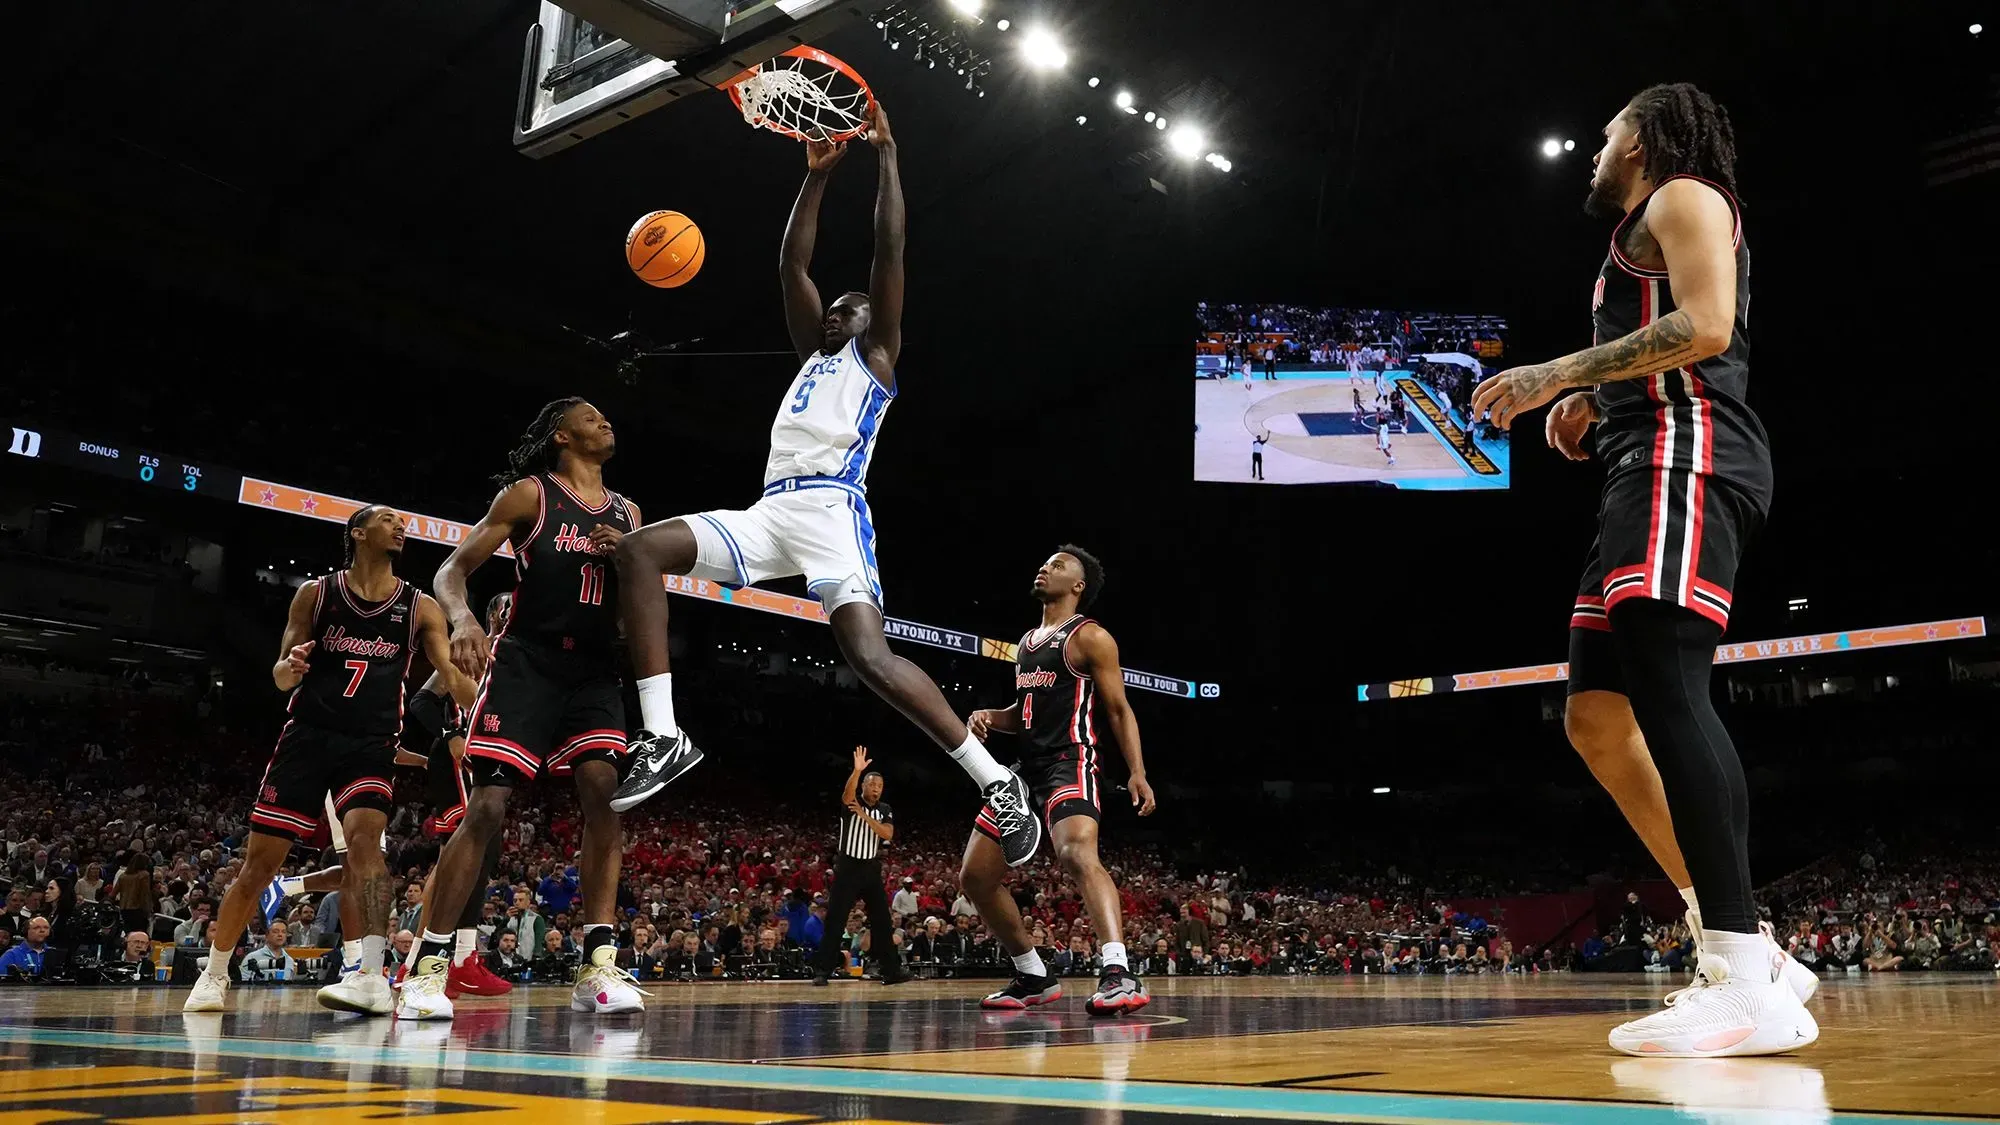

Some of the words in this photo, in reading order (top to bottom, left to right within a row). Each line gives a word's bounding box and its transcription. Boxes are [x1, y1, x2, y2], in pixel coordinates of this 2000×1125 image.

[791, 379, 816, 414] 9
[79, 442, 119, 458] BONUS
[139, 455, 160, 467] FLS
[140, 466, 154, 482] 0
[182, 464, 202, 477] TOL
[183, 475, 197, 491] 3
[405, 517, 462, 541] AND
[579, 561, 605, 606] 11
[666, 574, 709, 596] ERE
[322, 624, 400, 658] Houston
[884, 621, 942, 644] ANTONIO,
[945, 634, 962, 648] TX
[1755, 637, 1822, 657] WERE
[1834, 631, 1850, 649] 4
[343, 659, 369, 698] 7
[1016, 665, 1057, 690] ouston
[1123, 672, 1152, 687] FINAL
[1154, 678, 1178, 692] FOUR
[1202, 685, 1218, 696] CC
[1022, 692, 1033, 729] 4
